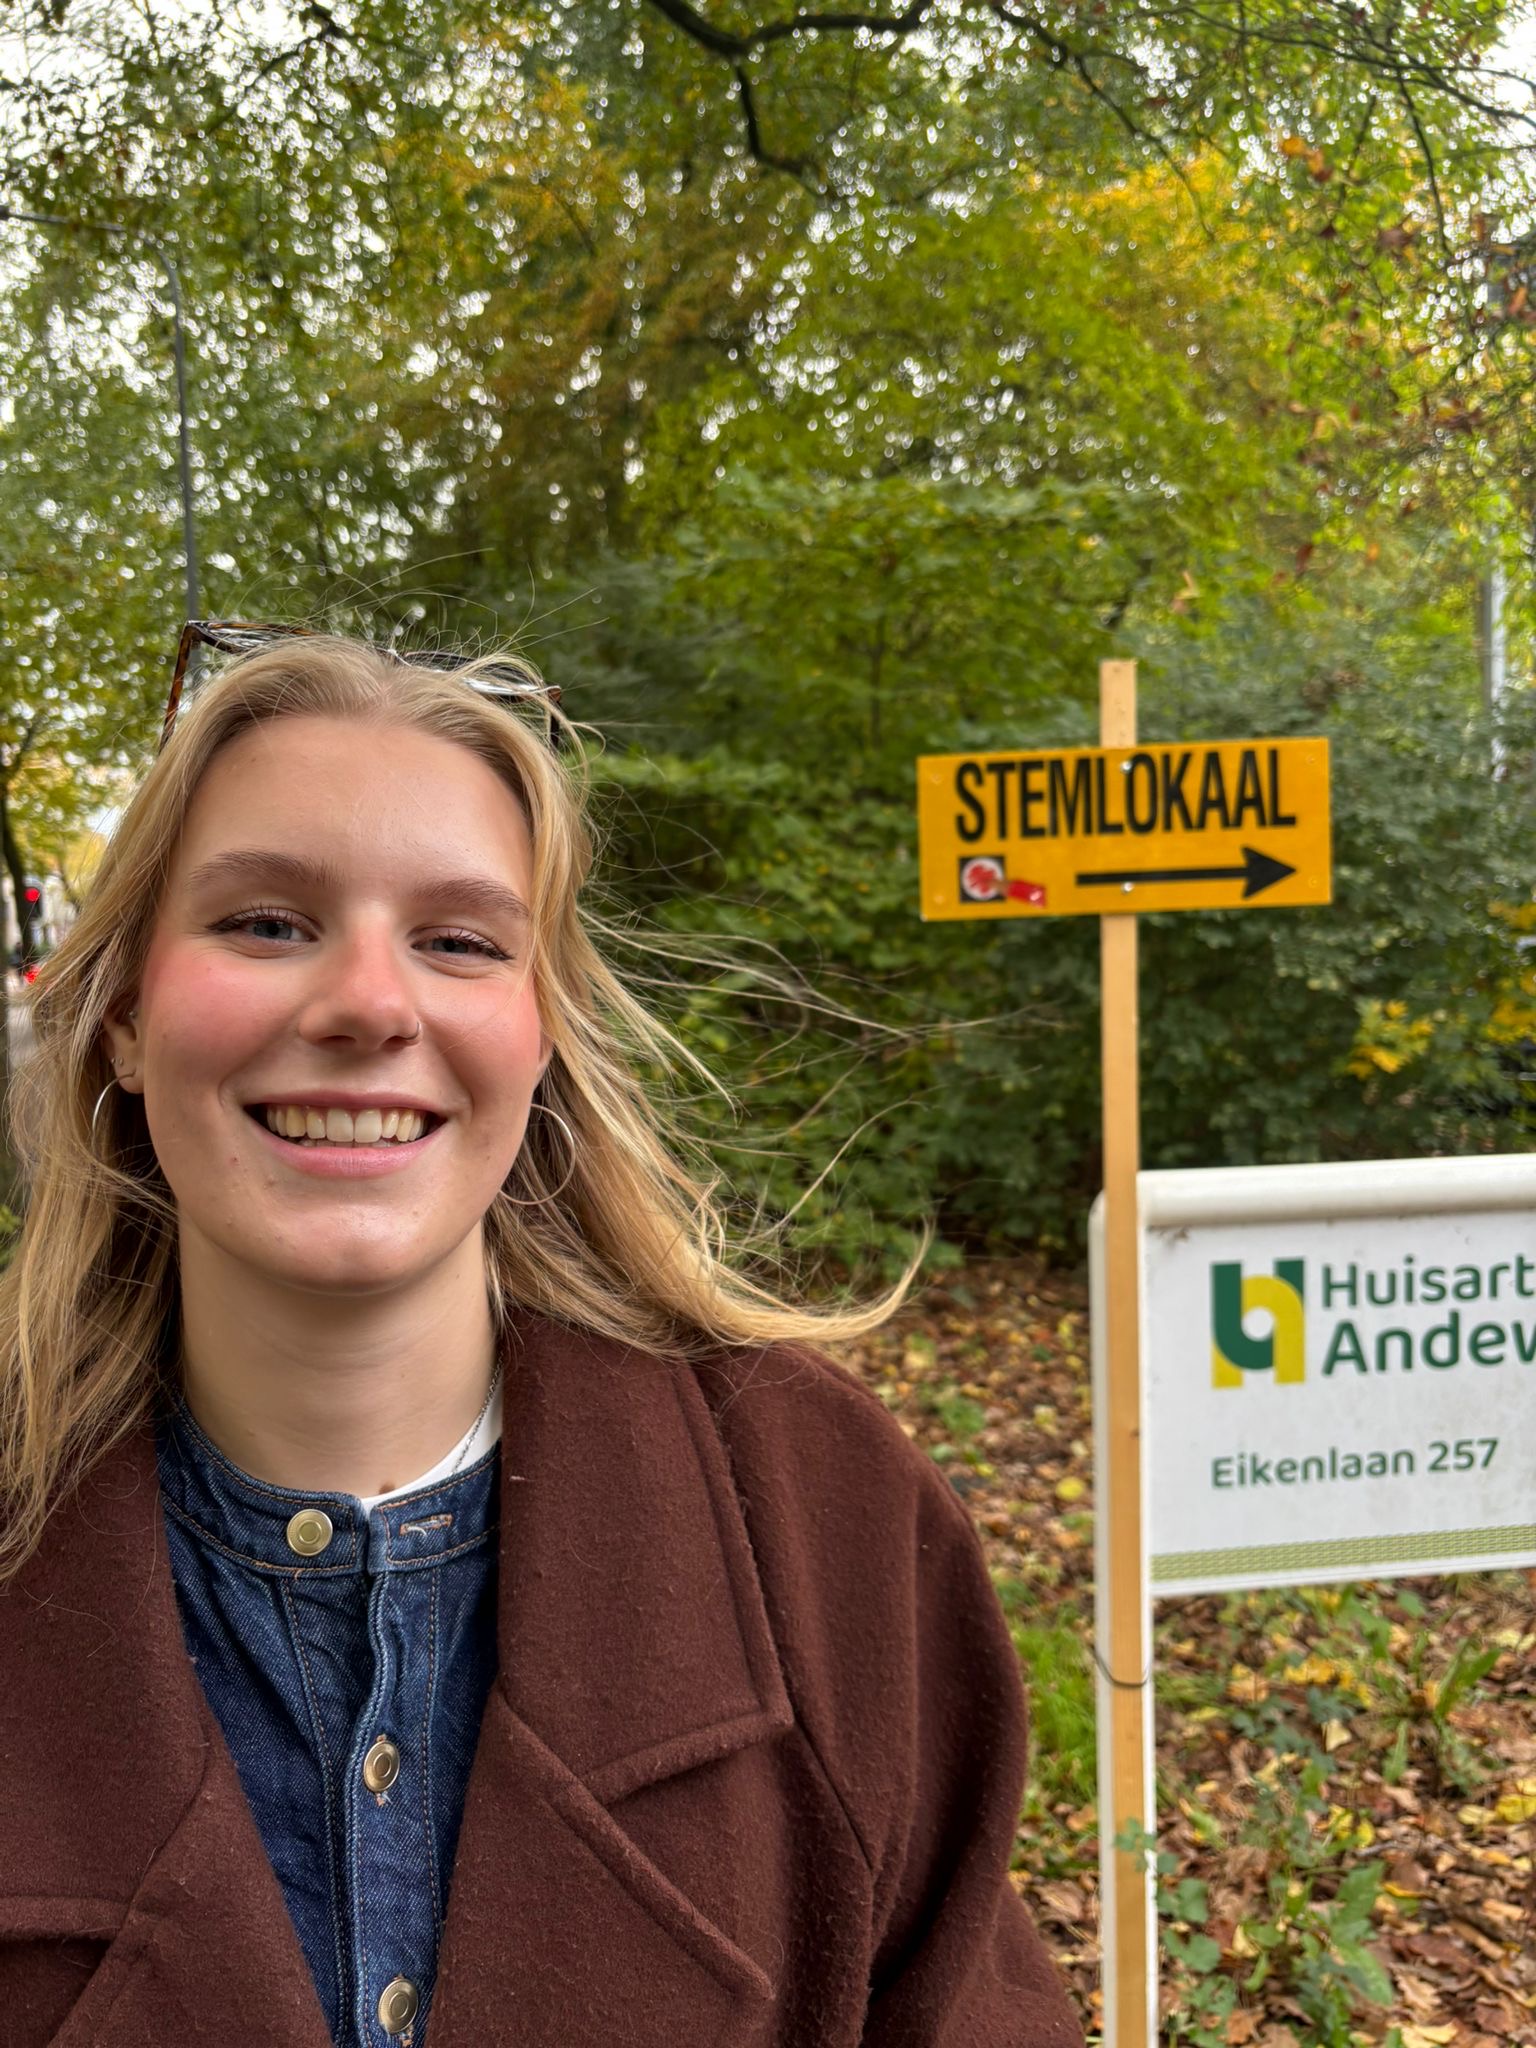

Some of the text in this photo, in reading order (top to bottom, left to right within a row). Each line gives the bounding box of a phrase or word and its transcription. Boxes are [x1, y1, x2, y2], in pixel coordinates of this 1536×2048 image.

[955, 749, 1296, 843] STEMLOKAAL
[1322, 1254, 1536, 1308] Huisart
[1211, 1438, 1499, 1488] Eikenlaan 257
